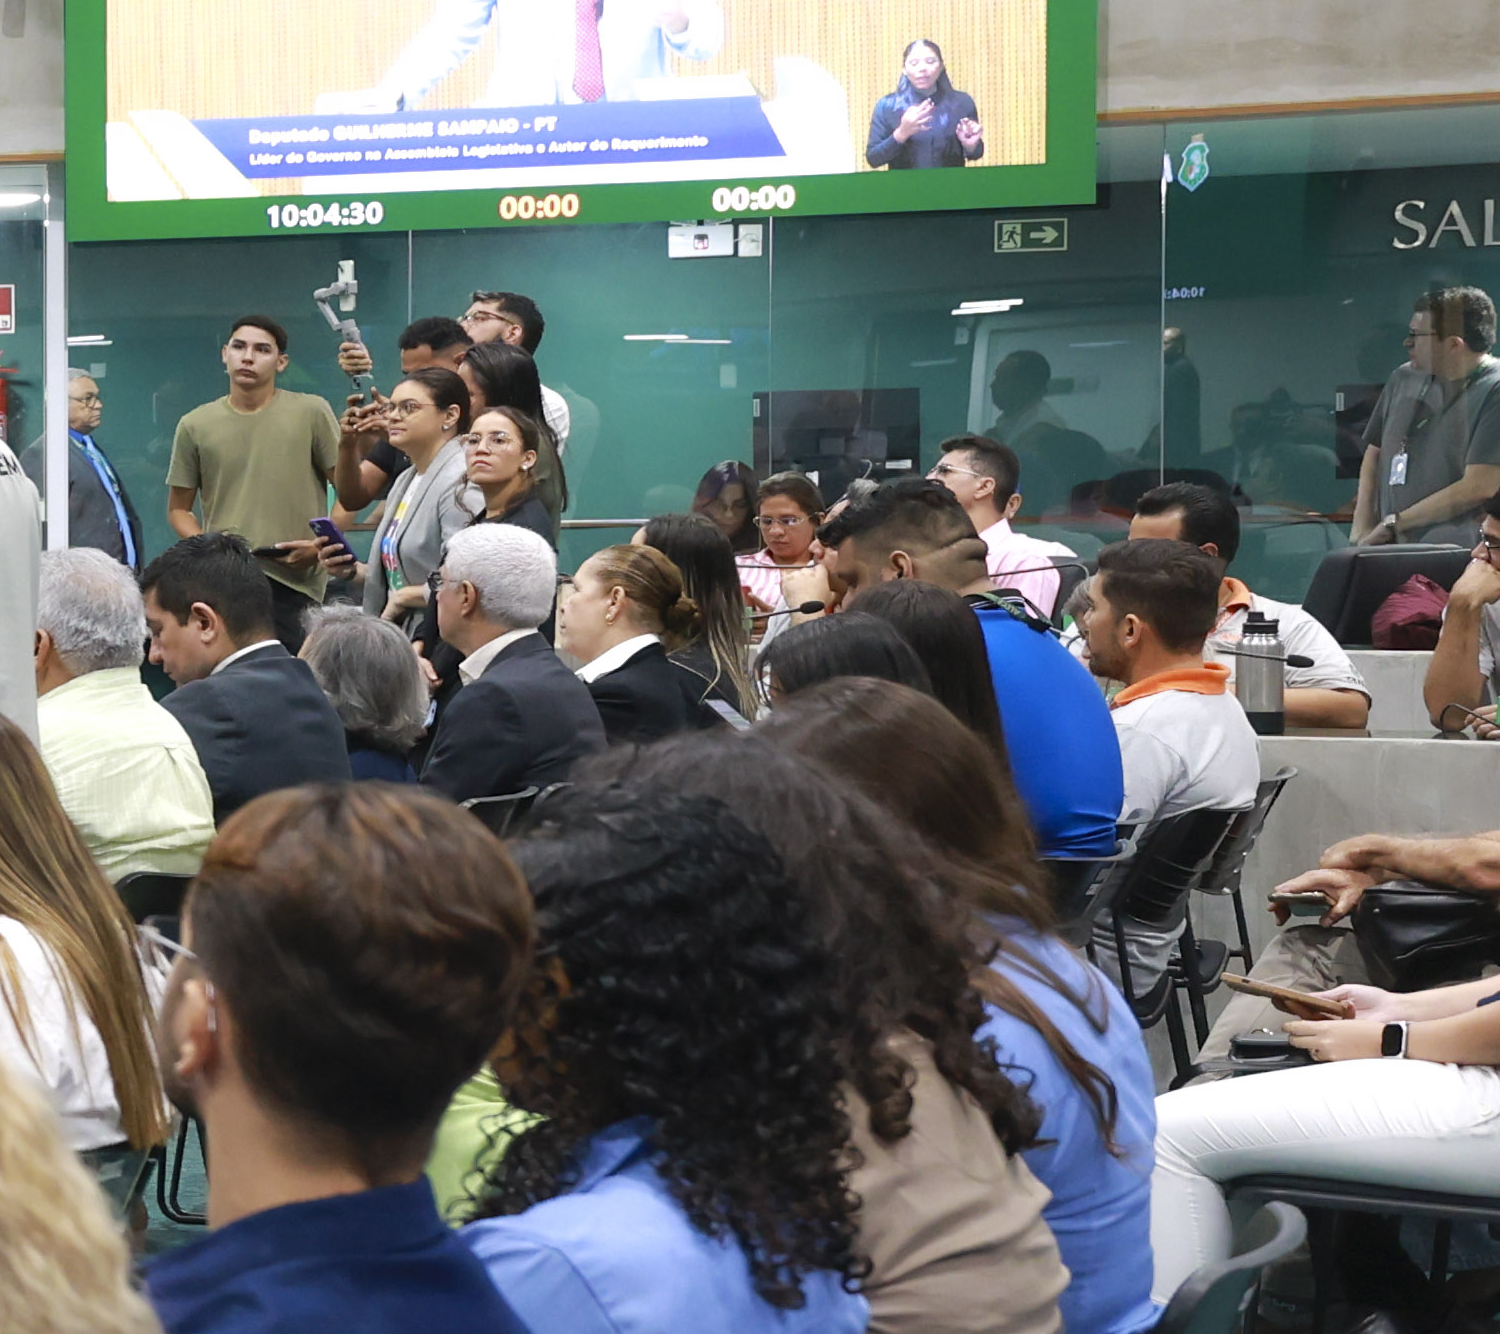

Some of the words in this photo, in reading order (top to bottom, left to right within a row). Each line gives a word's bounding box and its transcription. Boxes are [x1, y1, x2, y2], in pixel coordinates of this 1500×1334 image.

[248, 126, 330, 146] Deputado
[333, 122, 434, 141] GUILHERME
[437, 118, 519, 137] SAMPAIO
[534, 116, 558, 132] PT
[306, 150, 362, 163] Governo
[462, 142, 534, 158] Legislativa
[611, 135, 709, 152] Requerimento
[498, 194, 580, 220] 00:00
[711, 184, 796, 212] 00:00
[267, 201, 384, 228] 10:04:30
[1392, 199, 1500, 249] SAL
